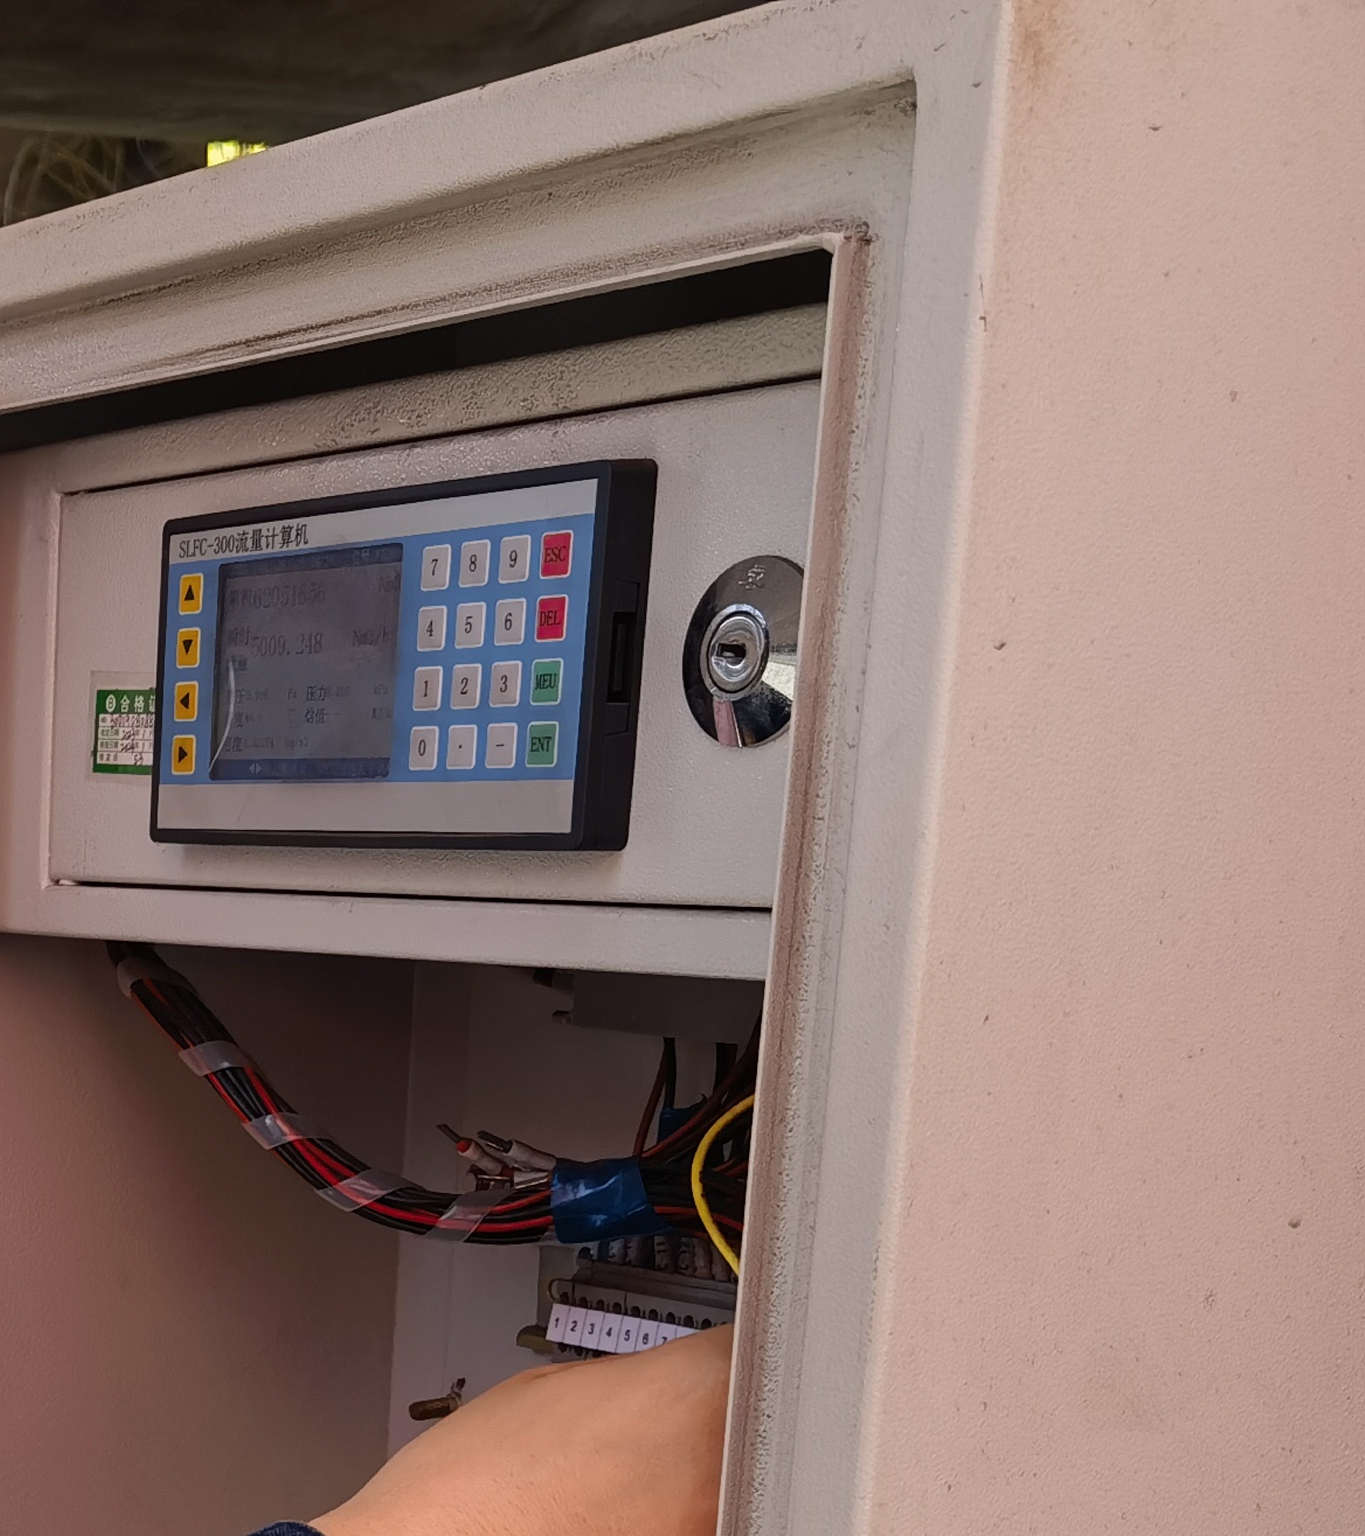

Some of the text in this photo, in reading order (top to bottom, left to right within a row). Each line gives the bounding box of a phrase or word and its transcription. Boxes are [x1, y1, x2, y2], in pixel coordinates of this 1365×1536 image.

[179, 523, 309, 559] SLFC-300流量计算机
[431, 547, 567, 576] 7 8 9 ESC
[426, 609, 560, 637] 4 5 6 DEL
[423, 673, 558, 697] 1 2 3 MEU
[418, 736, 552, 757] 0 ENT
[554, 1317, 560, 1329] 1
[570, 1320, 577, 1333] 2
[588, 1322, 595, 1335] 3
[605, 1325, 613, 1338] 4
[623, 1329, 631, 1342] 5
[642, 1333, 649, 1345] 6
